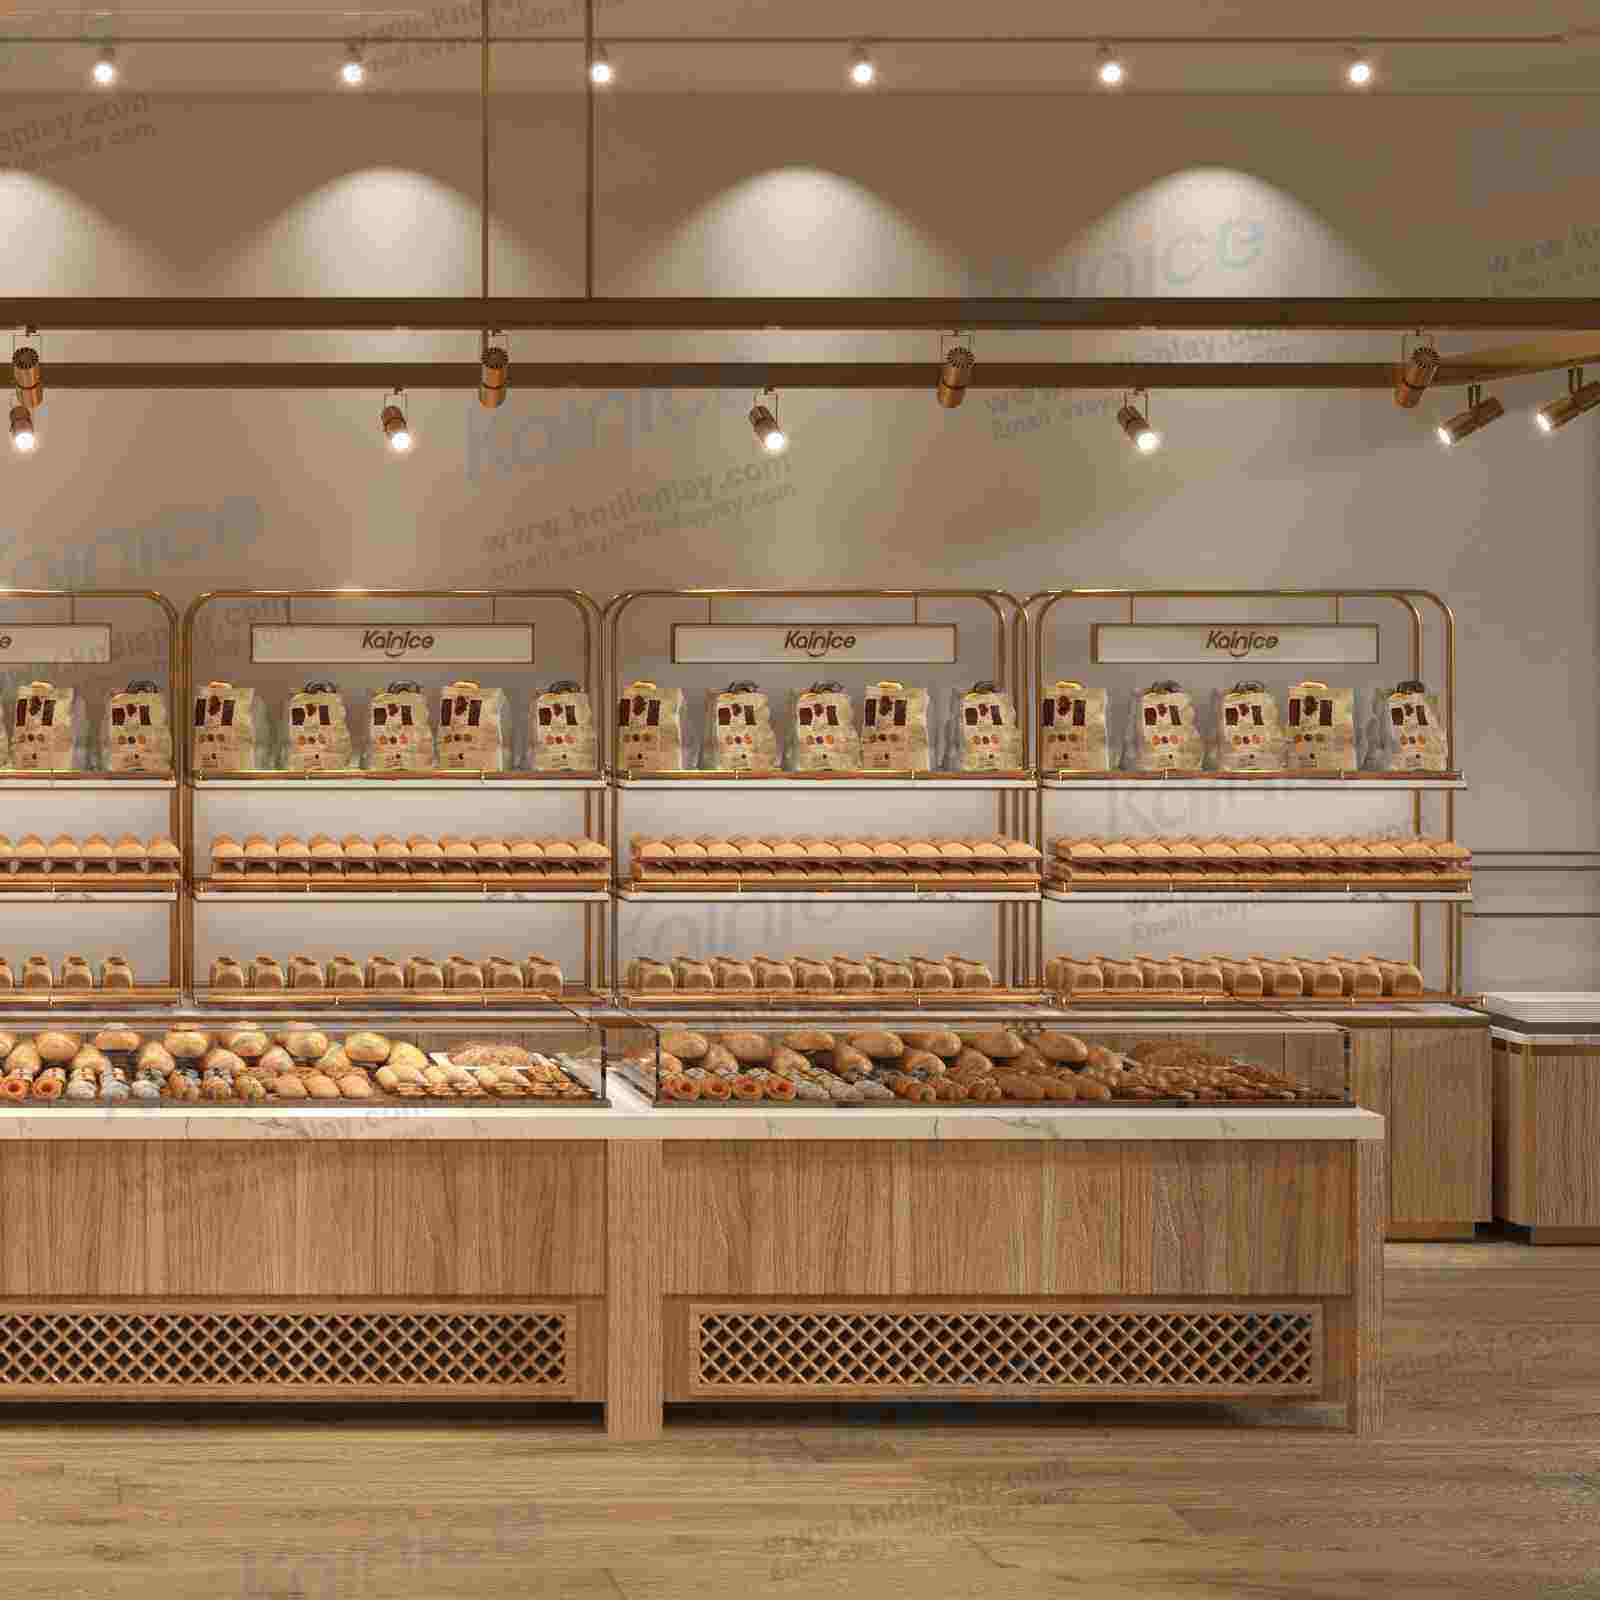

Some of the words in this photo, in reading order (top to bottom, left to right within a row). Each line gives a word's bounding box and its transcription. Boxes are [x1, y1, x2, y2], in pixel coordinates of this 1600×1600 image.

[362, 630, 434, 657] Kainice
[784, 630, 856, 657] Kainice
[1206, 630, 1279, 657] Kainice
